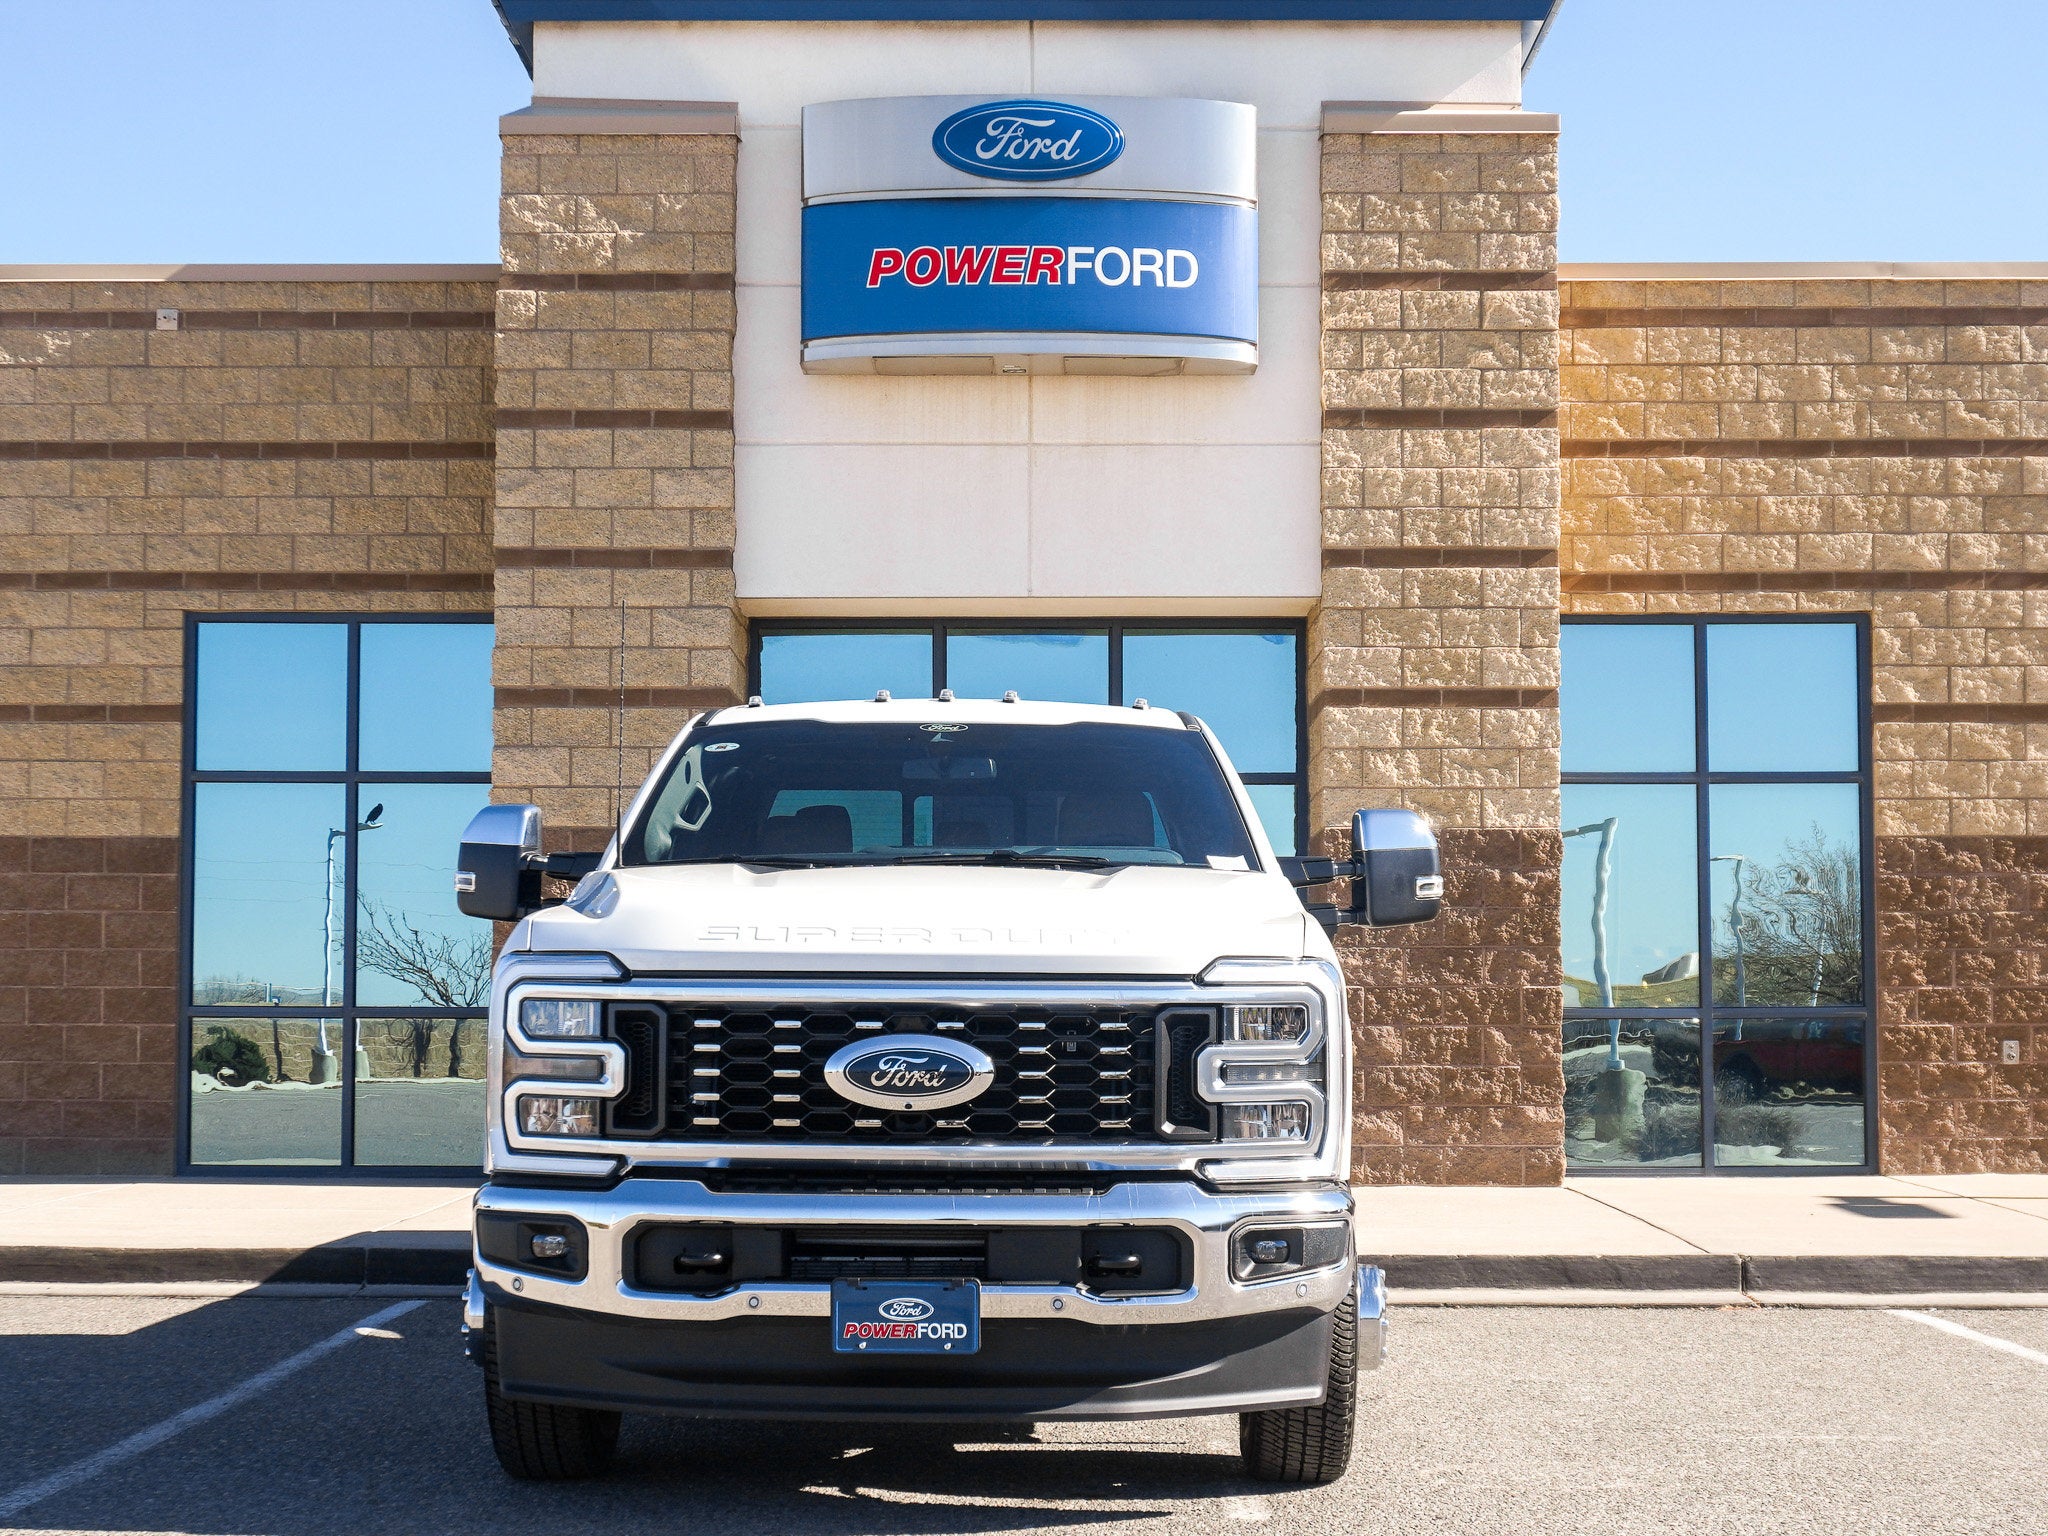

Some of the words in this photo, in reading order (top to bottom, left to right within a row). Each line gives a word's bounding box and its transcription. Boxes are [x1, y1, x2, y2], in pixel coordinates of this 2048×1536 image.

[975, 116, 1083, 161] Ford
[865, 245, 1199, 288] POWERFORD
[698, 924, 931, 944] SUPER
[870, 1055, 948, 1087] Ford
[889, 1301, 922, 1317] Ford
[843, 1322, 967, 1339] POWERFORD
